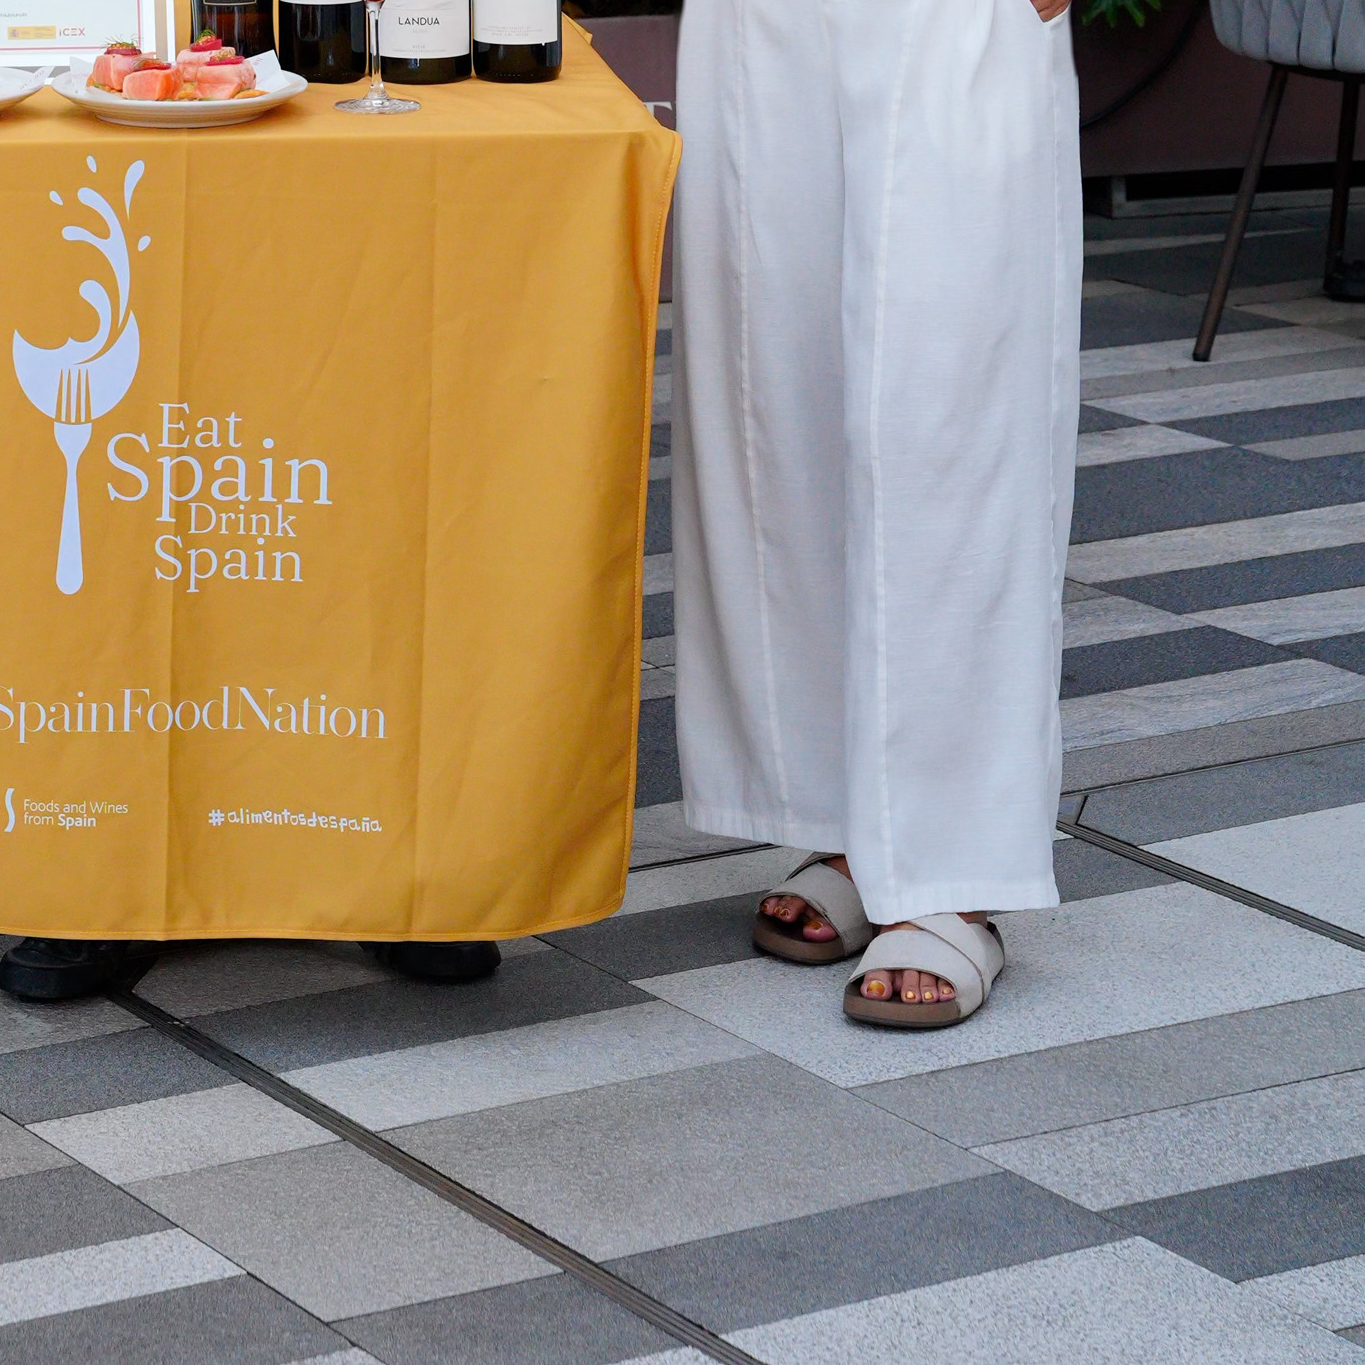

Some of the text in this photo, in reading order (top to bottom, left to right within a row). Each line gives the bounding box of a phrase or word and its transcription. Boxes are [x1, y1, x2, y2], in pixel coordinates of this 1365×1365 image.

[398, 16, 440, 26] LANDUA
[158, 403, 242, 449] Eat
[106, 431, 333, 523] Spain
[187, 502, 297, 539] Drink
[154, 534, 304, 593] Spain
[23, 799, 128, 815] Foods and Wines
[23, 812, 97, 830] from Spain
[208, 807, 383, 834] #alimentosdespaña
